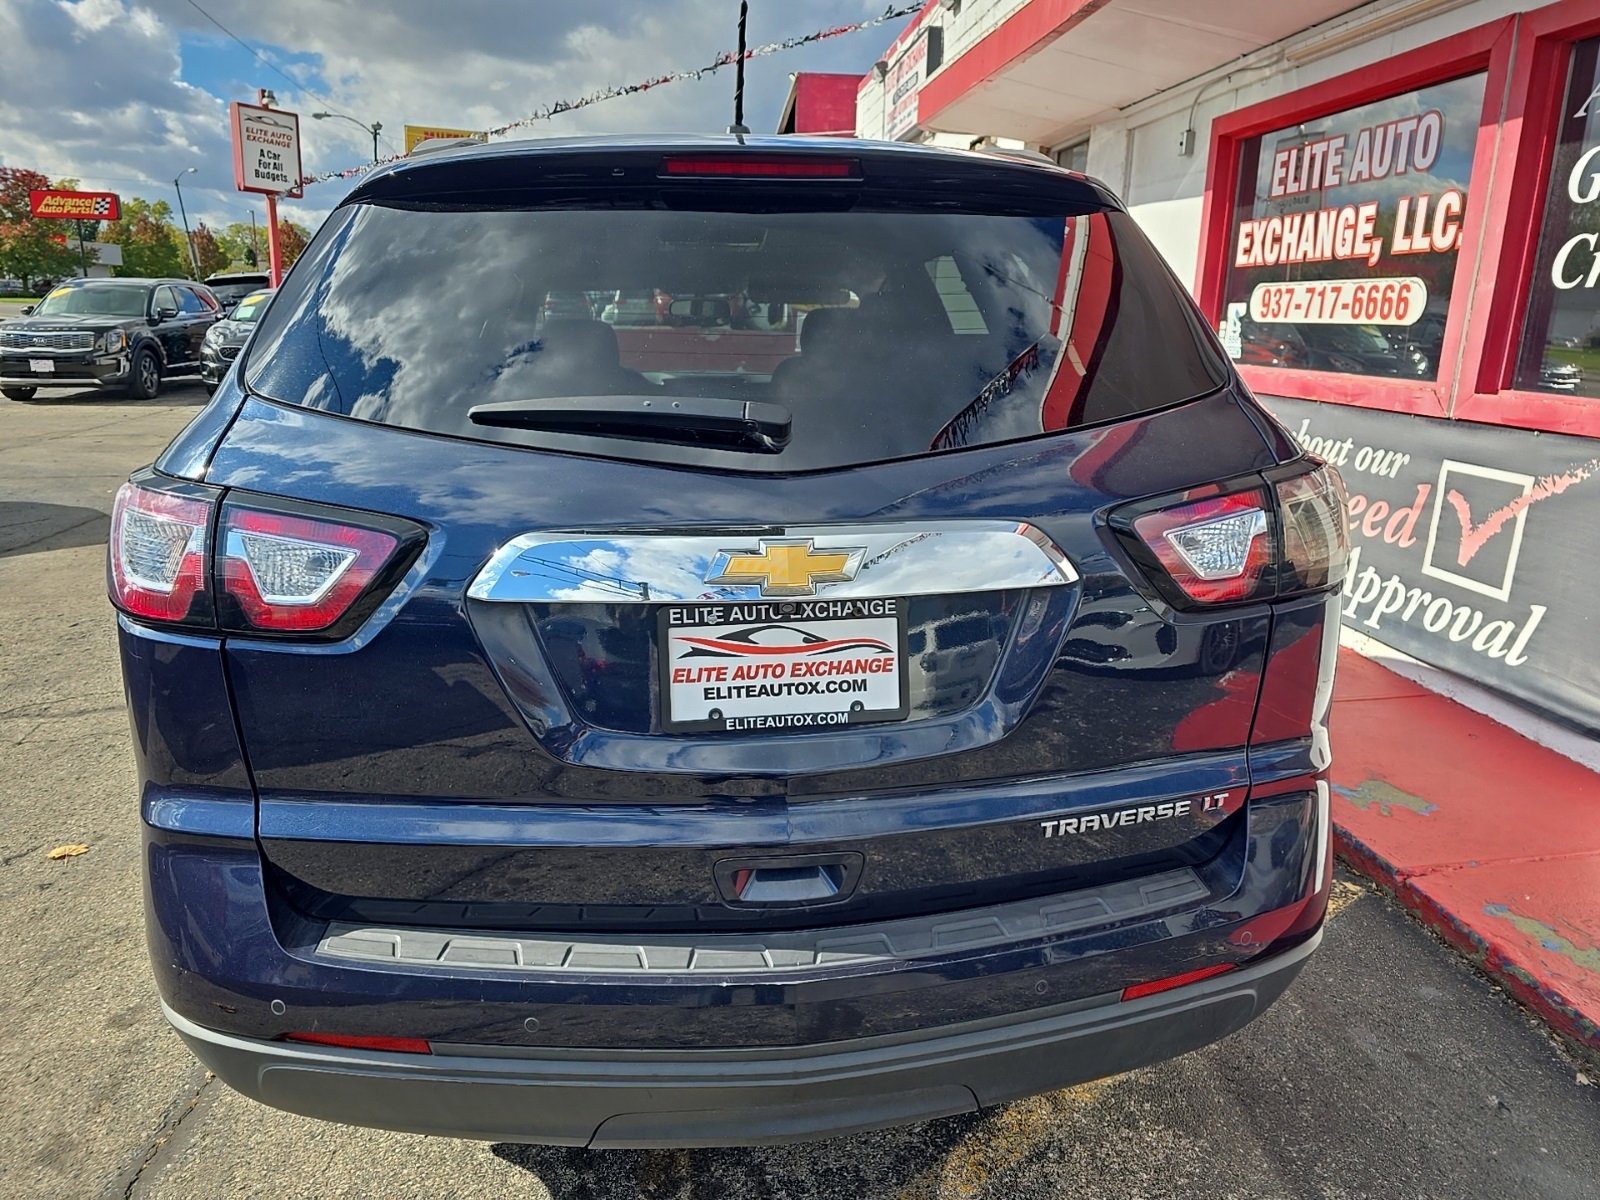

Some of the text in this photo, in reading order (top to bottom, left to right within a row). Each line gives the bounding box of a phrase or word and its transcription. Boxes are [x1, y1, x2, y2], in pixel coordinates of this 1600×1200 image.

[246, 127, 292, 141] ELITE AUTO
[247, 134, 291, 148] EXCHANGE
[258, 159, 283, 172] For All
[259, 149, 280, 160] A Car
[1269, 109, 1445, 199] ELITE AUTO
[36, 204, 90, 215] Auto Parts
[41, 195, 92, 207] Advance
[1235, 201, 1385, 268] EXCHANGE,
[1260, 282, 1412, 322] 937-717-6666
[1292, 418, 1410, 479] bout our
[1343, 484, 1431, 548] eed
[669, 607, 724, 625] ELITE
[791, 600, 897, 620] XCHANGE
[672, 657, 895, 684] ELITE AUTO EXCHANGE
[703, 678, 868, 701] ELITEAUTOX.COM
[726, 712, 849, 731] ELITEAUTOX.COM
[1041, 793, 1229, 838] TRAVERSE LT
